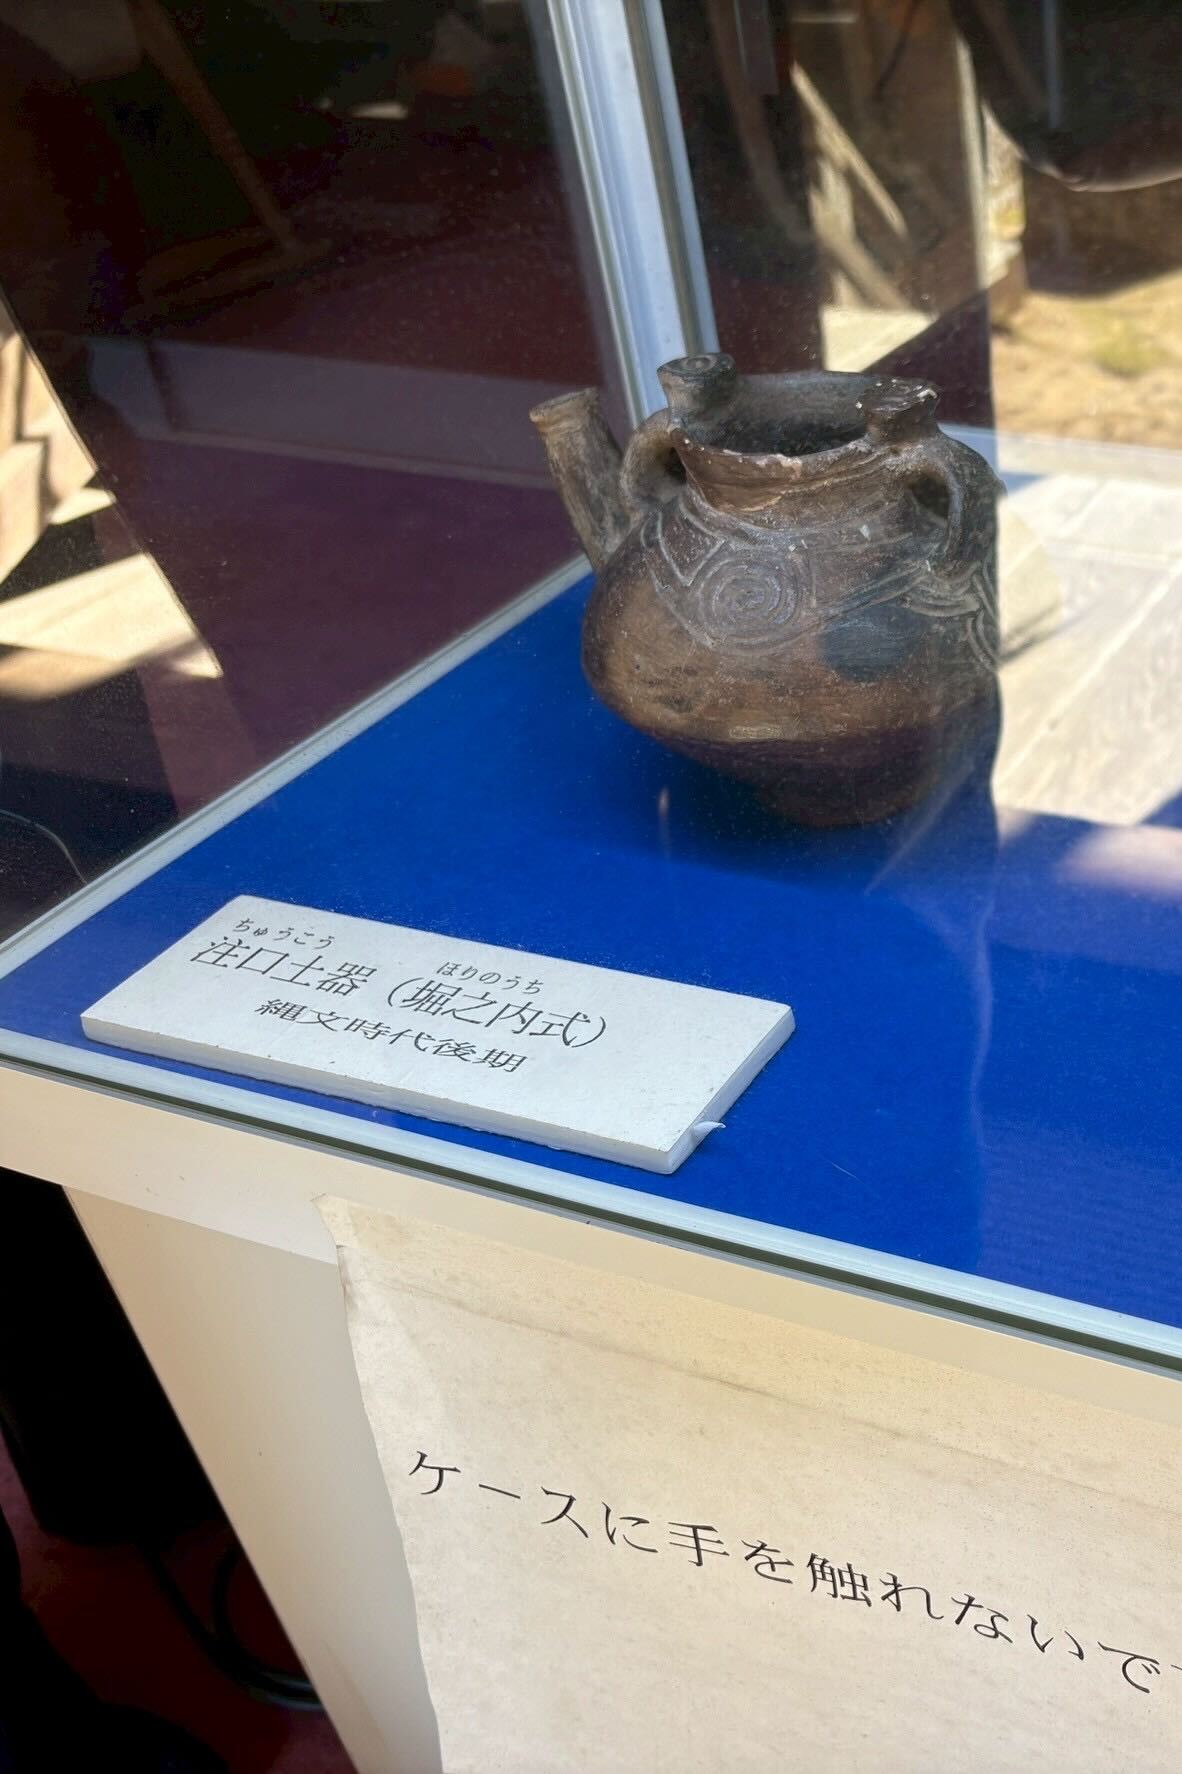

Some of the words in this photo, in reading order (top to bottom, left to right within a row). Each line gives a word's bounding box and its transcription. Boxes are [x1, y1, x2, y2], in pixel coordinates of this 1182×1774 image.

[231, 917, 336, 949] ちゅうこう
[436, 961, 545, 995] ほりのうち
[253, 998, 528, 1073] 縄文時代後期
